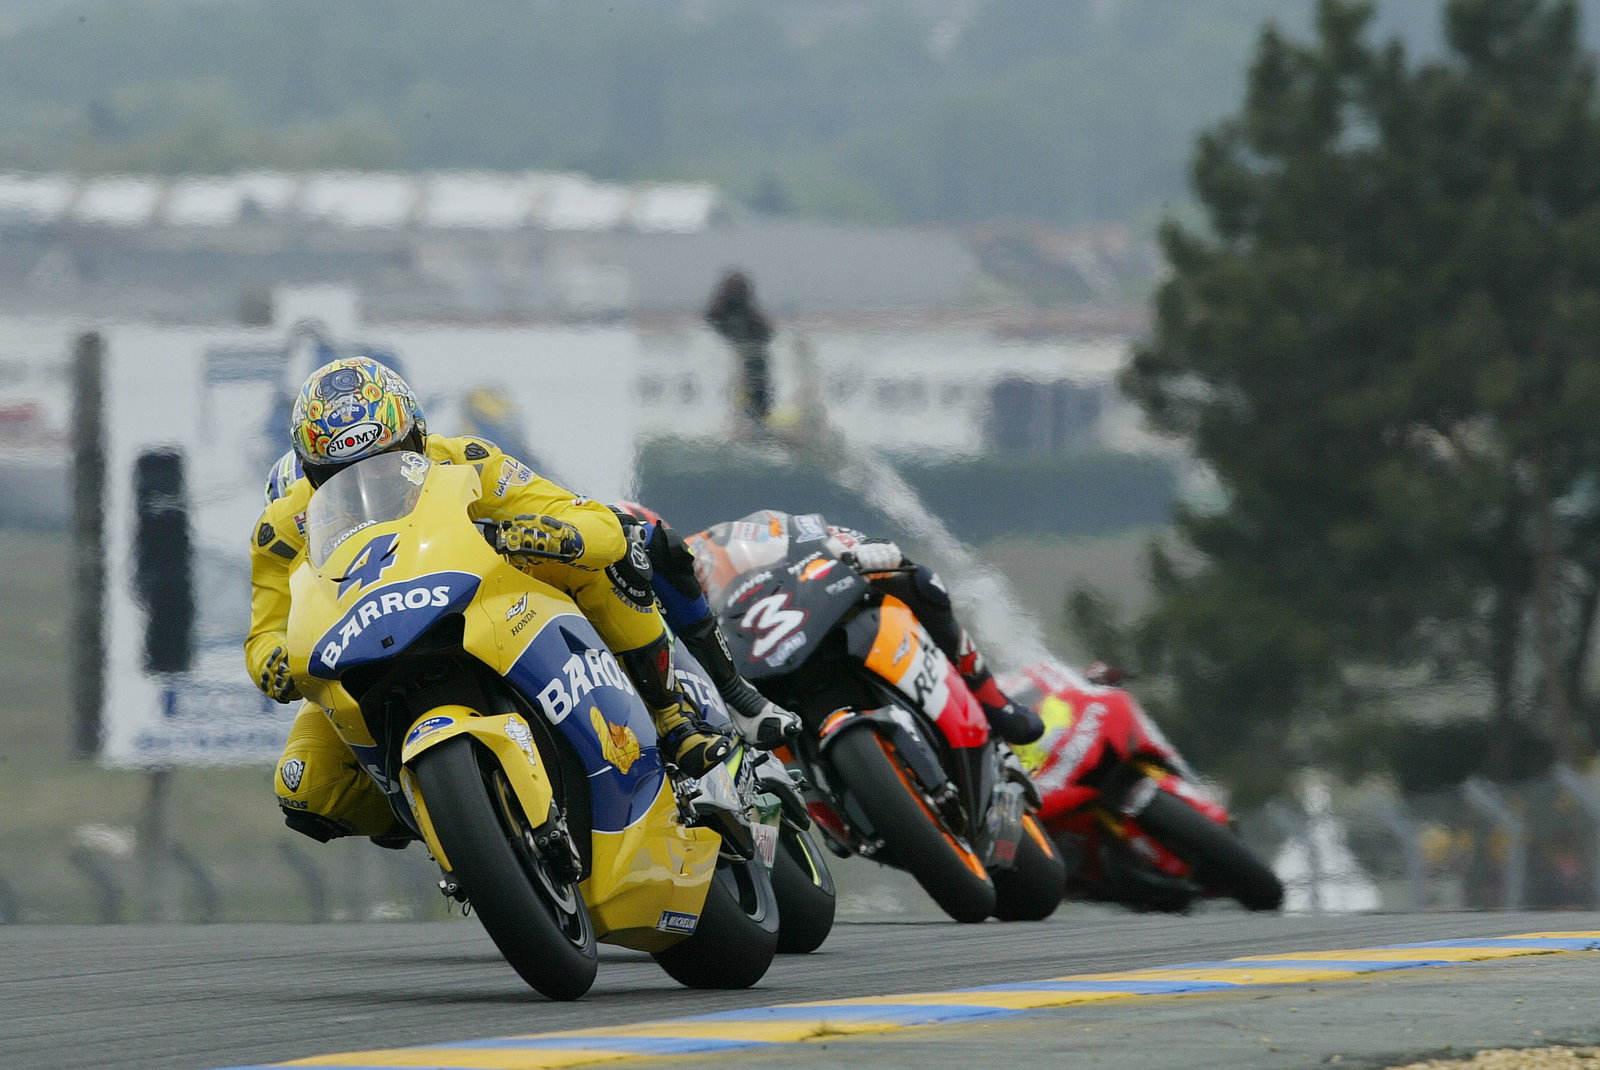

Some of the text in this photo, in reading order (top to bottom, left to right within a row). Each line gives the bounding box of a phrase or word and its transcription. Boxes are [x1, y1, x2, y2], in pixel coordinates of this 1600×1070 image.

[328, 428, 378, 453] SUOMY
[334, 520, 377, 549] HONDA
[336, 532, 400, 603] 4
[320, 586, 450, 671] BARROS
[511, 609, 537, 636] HONDA
[740, 592, 808, 660] 3
